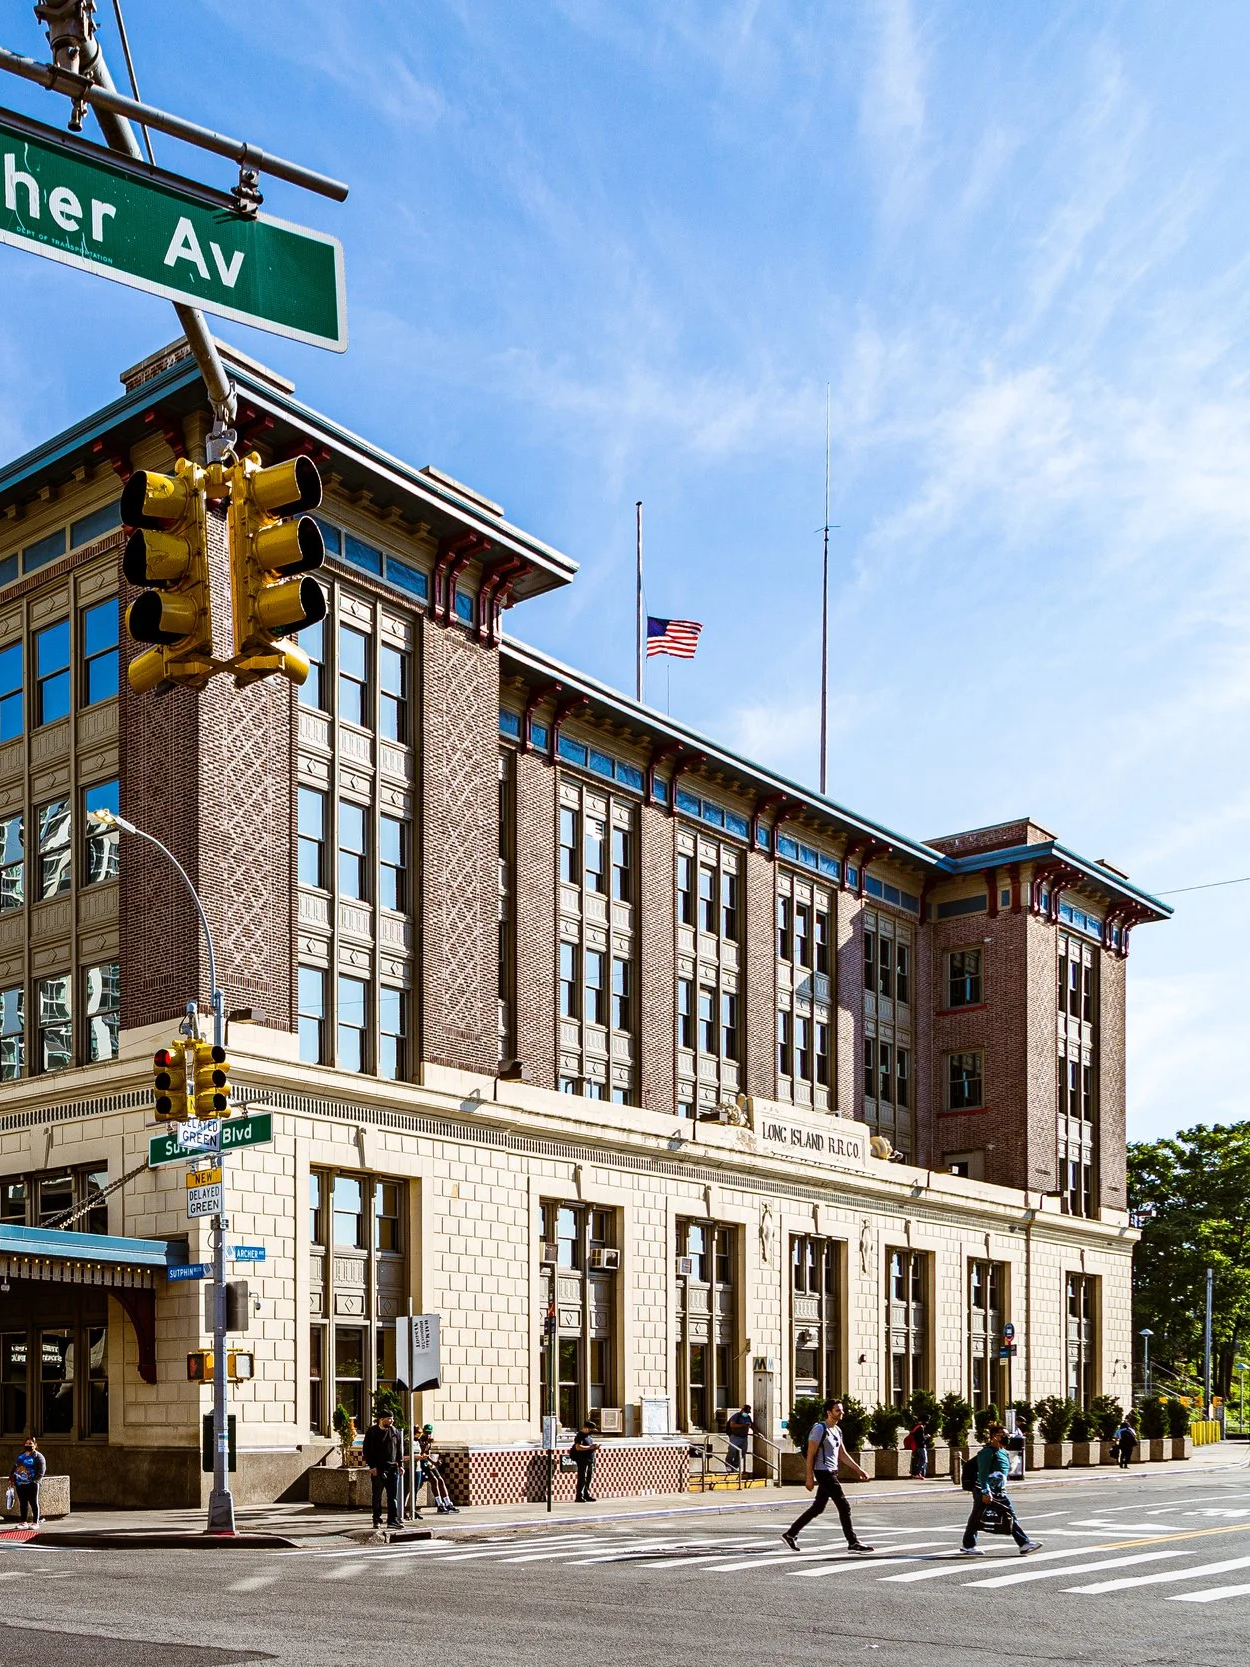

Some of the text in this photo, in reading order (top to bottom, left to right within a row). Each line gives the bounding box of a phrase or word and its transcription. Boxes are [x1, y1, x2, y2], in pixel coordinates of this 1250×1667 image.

[16, 226, 113, 264] DEPT OF TRANSPORTATION
[163, 217, 245, 288] Av
[183, 1130, 217, 1147] GREEN
[223, 1123, 252, 1144] Blvd
[762, 1121, 787, 1143] LONG
[790, 1128, 824, 1152] ISLAND
[195, 1171, 212, 1184] NEW
[189, 1186, 219, 1201] DELAYED
[190, 1200, 219, 1213] GREEN
[236, 1249, 258, 1258] ARCHER
[170, 1267, 193, 1278] SUTPHIN
